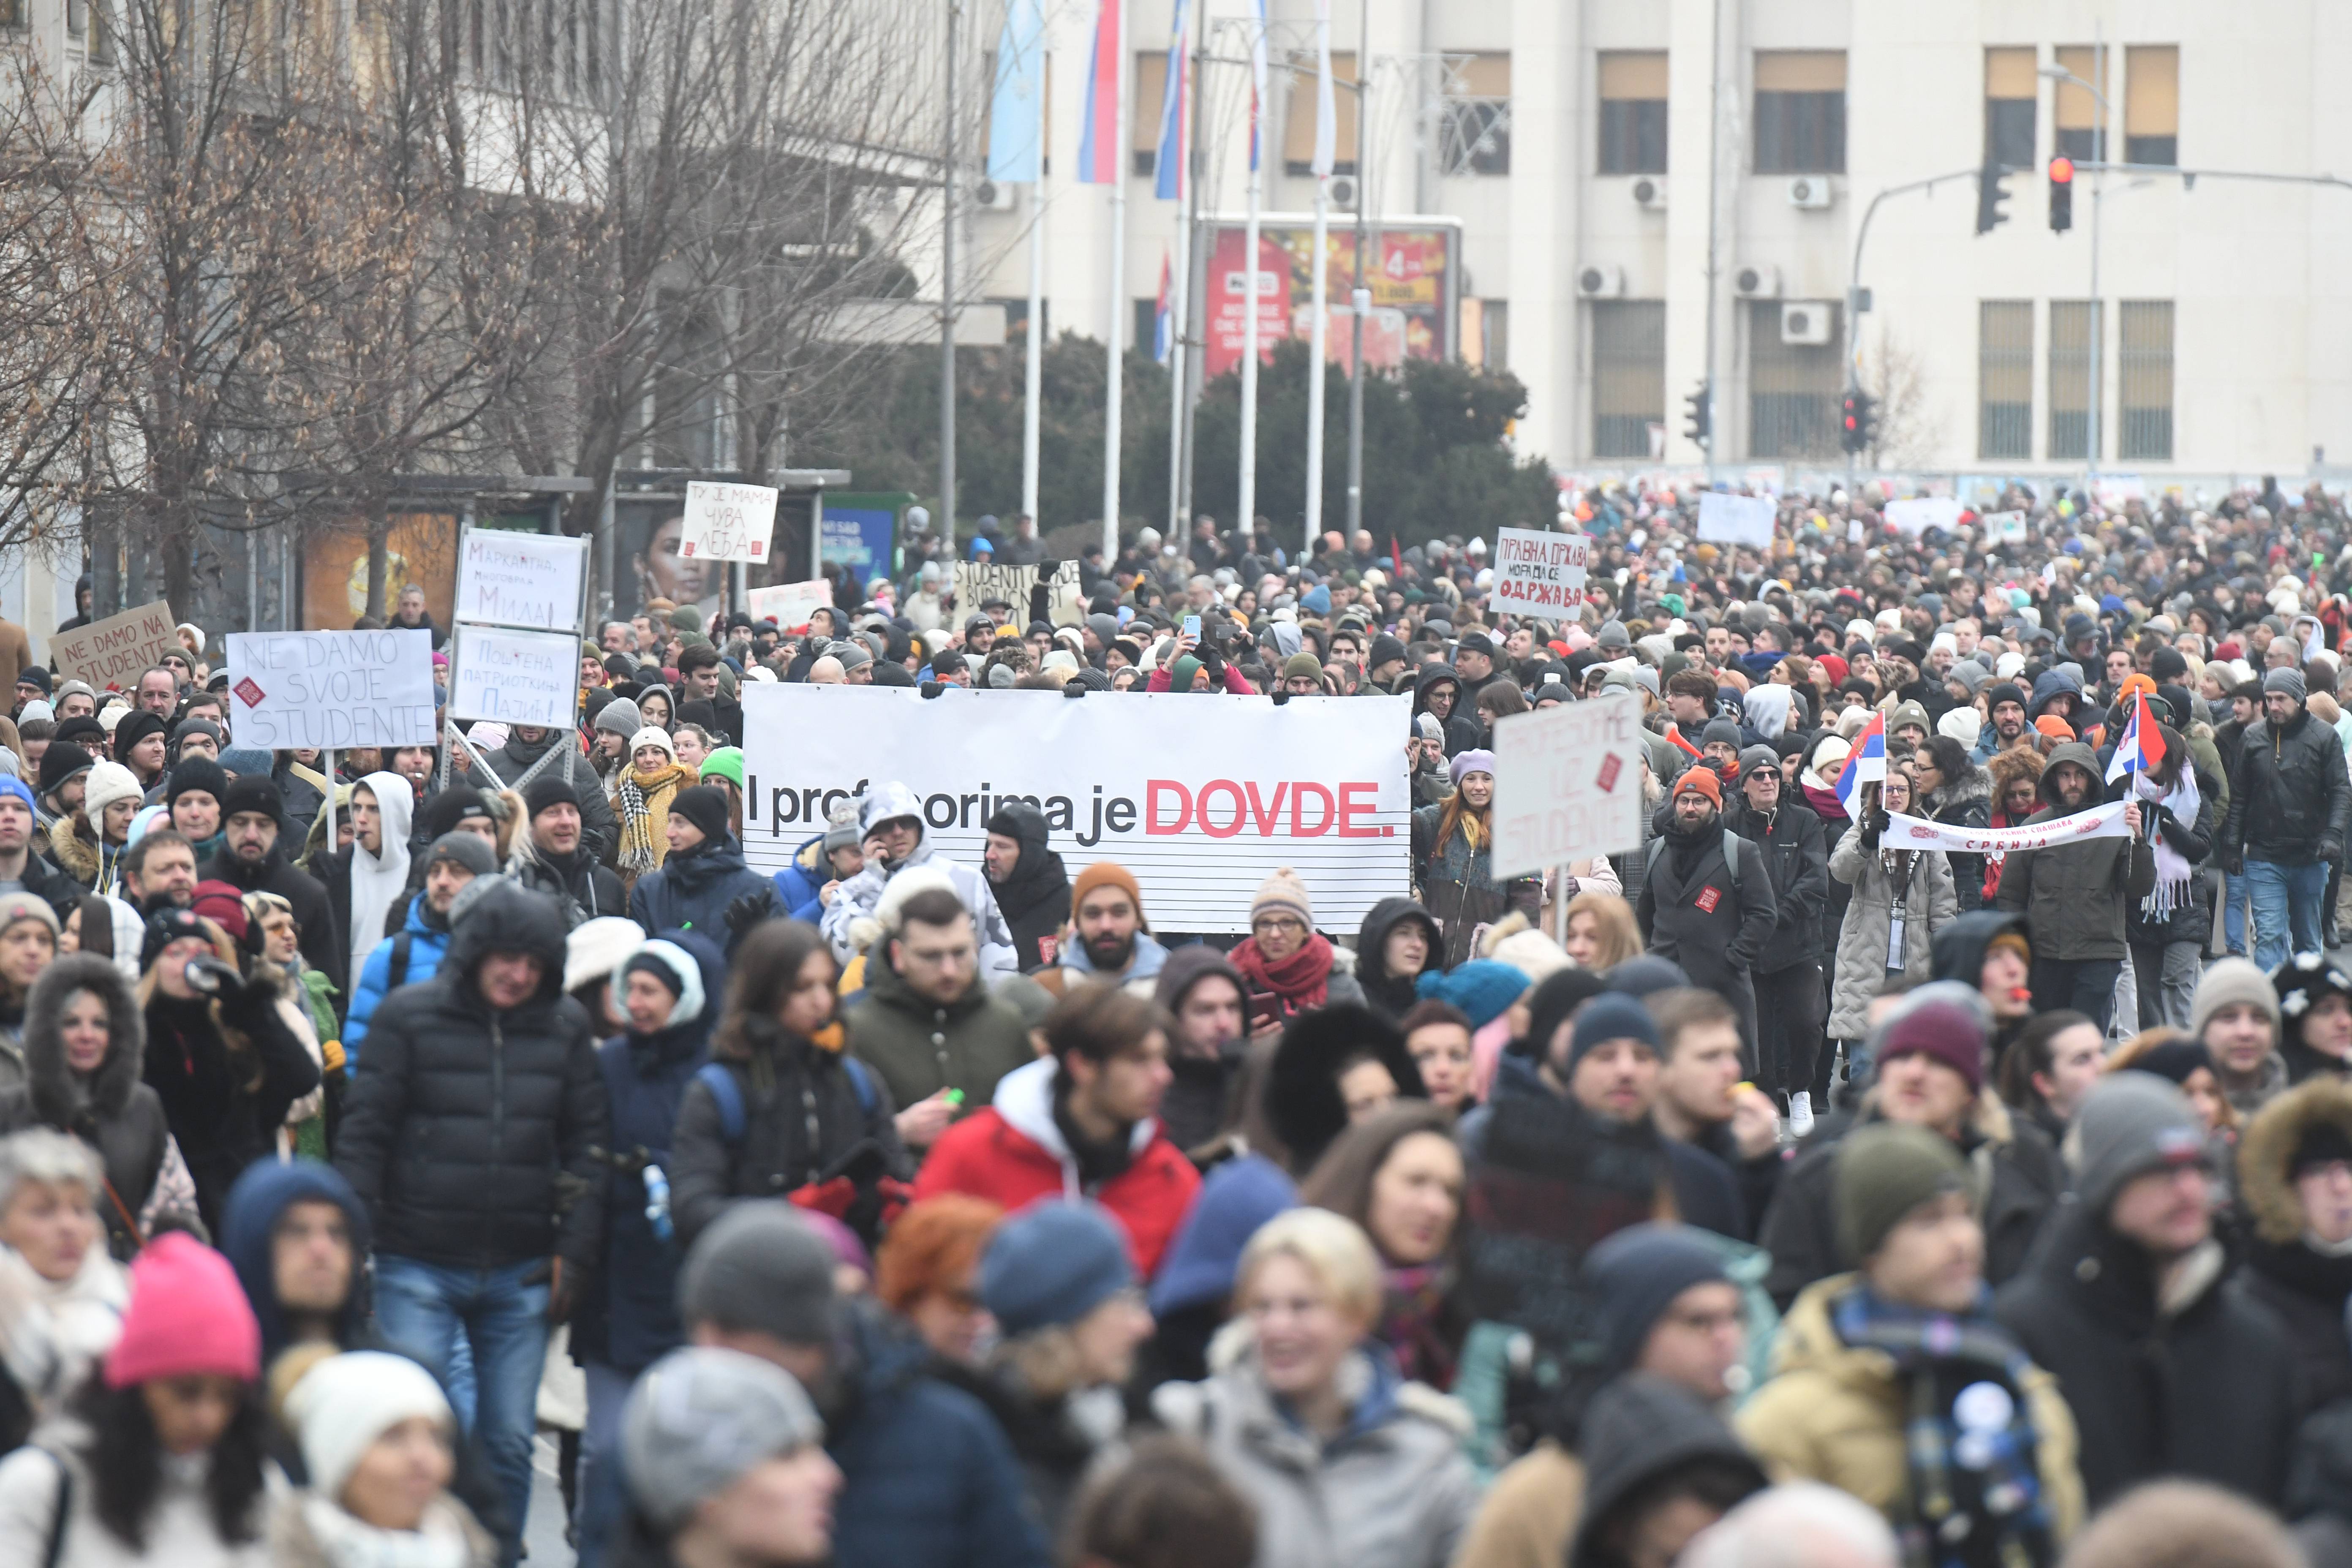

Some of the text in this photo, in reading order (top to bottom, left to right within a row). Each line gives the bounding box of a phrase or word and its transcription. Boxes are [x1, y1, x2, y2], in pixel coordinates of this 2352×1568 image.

[691, 486, 708, 498] ТУ
[732, 489, 771, 504] МАМА
[705, 507, 745, 528] ЧУВА
[694, 530, 749, 558] ЛЕЂА
[1500, 538, 1587, 567] ПРАВНА ДРЖАВА
[954, 561, 1025, 588] STUDENTI
[1508, 564, 1559, 580] МОРА ДА СЕ
[1500, 579, 1582, 607] ОДРЖАВА
[65, 615, 166, 662] NE DAMO NA
[244, 632, 397, 671] NE DAMO
[77, 637, 167, 684] STUDENTE
[283, 668, 388, 703] SVOJE
[250, 705, 436, 746] STUDENTE
[749, 775, 757, 821] I
[1075, 785, 1137, 847] je
[1146, 779, 1394, 838] DOVDE.
[2031, 819, 2073, 834] СПАШАВА
[1965, 838, 2047, 850] СРБИЈА
